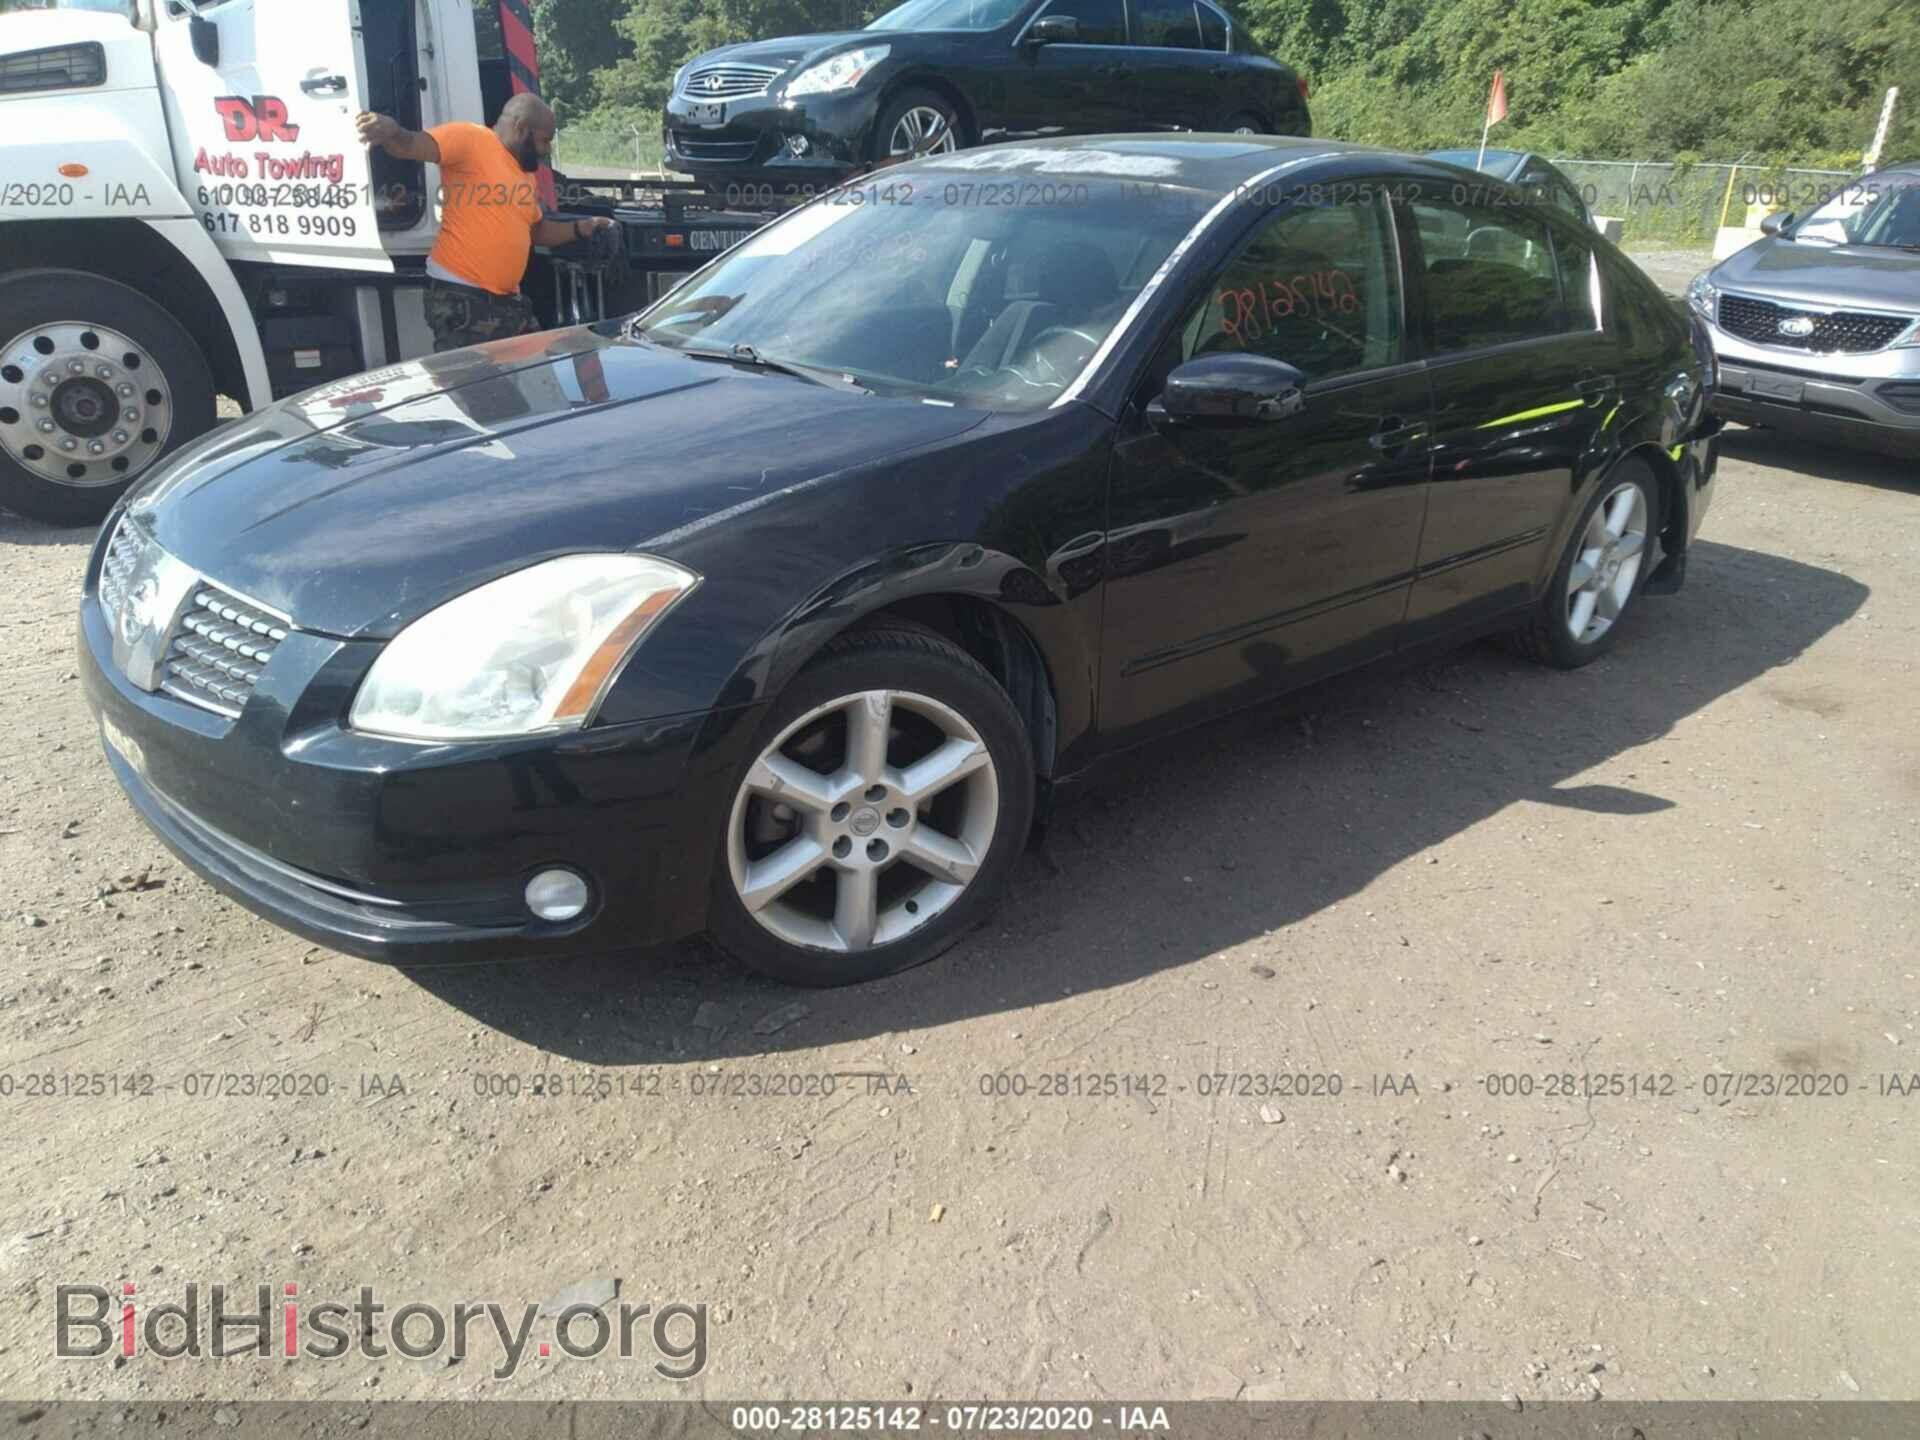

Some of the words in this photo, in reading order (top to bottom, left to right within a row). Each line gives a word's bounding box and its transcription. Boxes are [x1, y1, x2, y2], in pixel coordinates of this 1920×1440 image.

[194, 148, 249, 178] Auto
[254, 152, 344, 183] Towing
[204, 211, 240, 233] 617
[249, 213, 290, 233] 818
[297, 215, 356, 236] 9909
